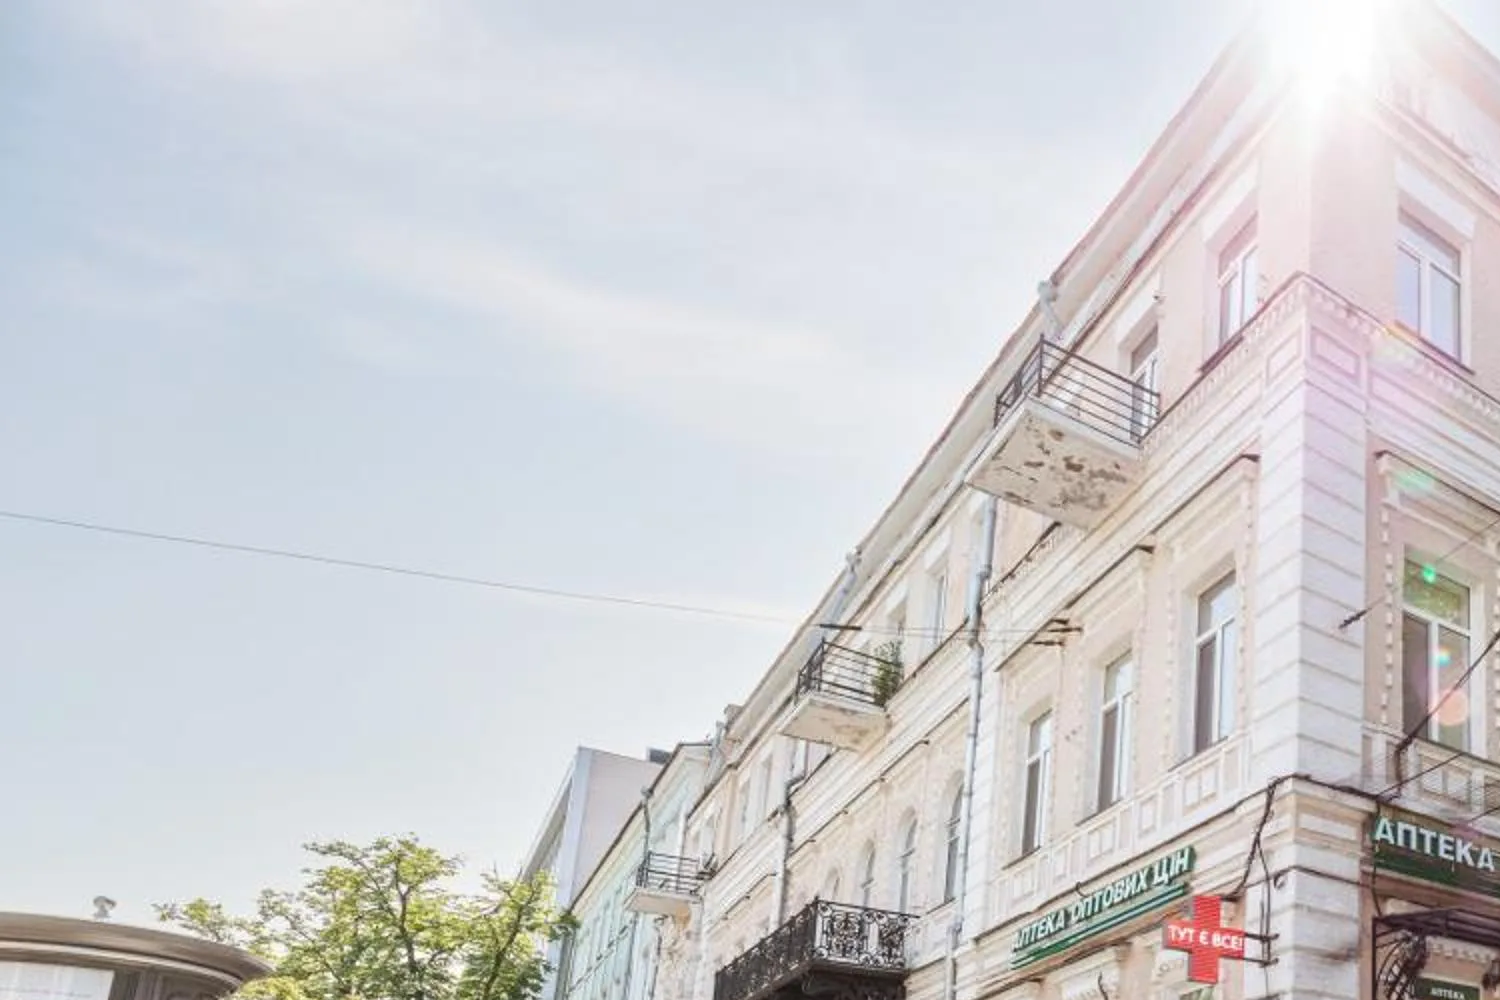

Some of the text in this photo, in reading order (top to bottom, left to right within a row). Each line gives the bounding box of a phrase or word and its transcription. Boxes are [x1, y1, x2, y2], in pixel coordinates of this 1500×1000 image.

[1375, 816, 1495, 873] АПТЕКА
[1012, 847, 1190, 951] АПТЕКА ОПТОВИХ ЦІН
[1167, 924, 1195, 945] ТУТ
